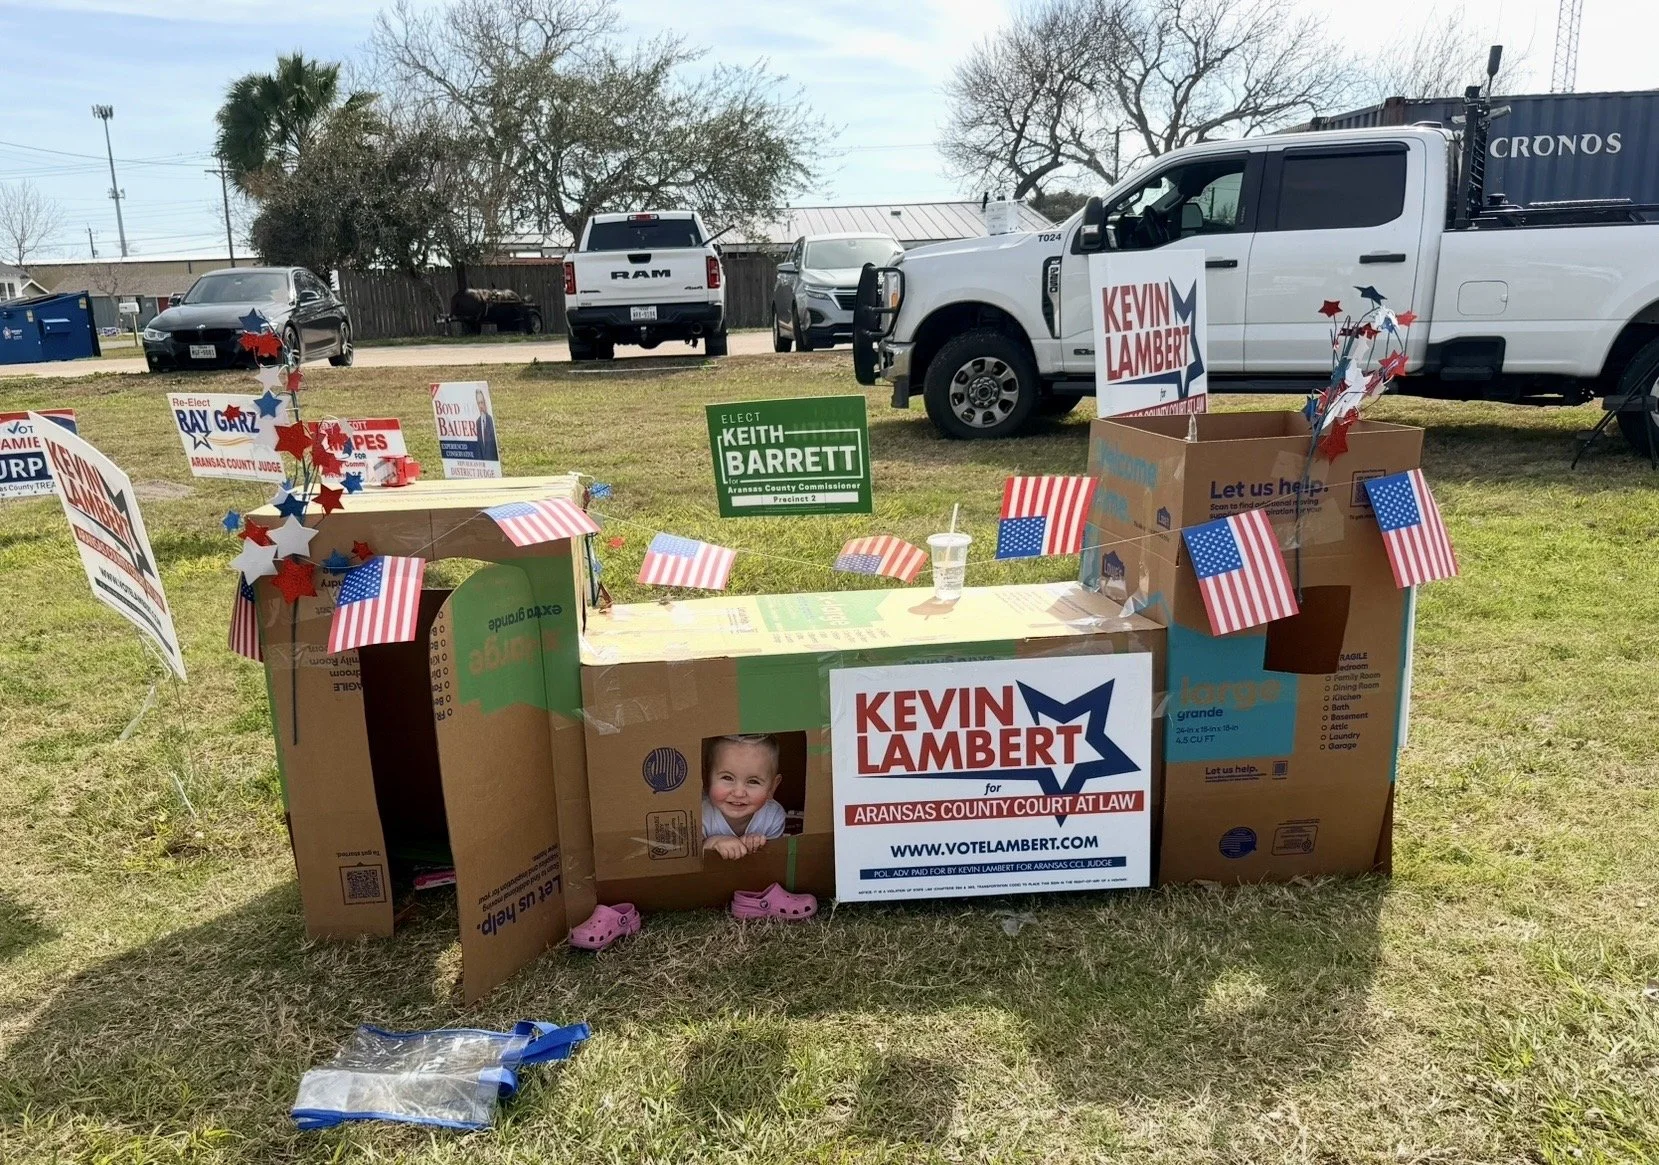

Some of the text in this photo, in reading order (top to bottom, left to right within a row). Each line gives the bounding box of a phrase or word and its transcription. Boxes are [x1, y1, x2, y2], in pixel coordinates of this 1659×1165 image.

[1489, 132, 1622, 158] CRONOS
[1038, 233, 1061, 242] T024
[611, 269, 671, 280] RAM
[1102, 282, 1170, 334] KEVIN
[1105, 325, 1189, 381] LAMBERT
[172, 398, 211, 407] Re-Elect
[435, 400, 460, 415] BOYD
[175, 410, 260, 433] RAY GARZ
[721, 412, 761, 424] ELECT
[8, 421, 34, 434] VOT
[438, 417, 478, 437] BAUER
[722, 424, 784, 446] KEITH
[1, 437, 41, 450] AMIE
[191, 457, 282, 473] ARANSAS COUNTY JUDGE
[725, 445, 856, 476] BARRETT
[44, 437, 107, 501] KEVIN
[9, 483, 34, 491] County
[728, 482, 860, 494] Aransas County Commissioner
[1210, 480, 1245, 499] Let
[1250, 482, 1273, 497] us
[773, 494, 816, 503] Precinct 2
[58, 472, 135, 550] LAMBERT
[1210, 503, 1229, 511] Scan
[1239, 500, 1253, 509] find
[1266, 508, 1293, 516] piration
[321, 579, 342, 589] ndry
[488, 604, 562, 633] extra grande
[340, 656, 359, 666] mily
[1339, 652, 1367, 660] RAGILE
[1338, 663, 1368, 671] edroom
[329, 670, 361, 679] droom
[1334, 672, 1380, 681] Family Room
[333, 681, 362, 692] AGILE
[1333, 682, 1379, 693] Dining Room
[1181, 676, 1280, 712] large
[1332, 693, 1361, 701] Kitchen
[856, 686, 1014, 733] KEVIN
[1331, 703, 1349, 711] Bath
[1177, 707, 1223, 721] grande
[1330, 712, 1368, 721] Basement
[1190, 735, 1203, 743] CU
[1329, 732, 1360, 741] Laundry
[857, 725, 1082, 775] LAMBERT
[1328, 742, 1357, 750] Garage
[1205, 766, 1221, 775] Let
[1235, 764, 1258, 773] help.
[984, 783, 1001, 796] for
[854, 793, 1136, 823] ARANSAS COUNTY COURT AT LAW
[891, 835, 1098, 858] WWW.VOTELAMBERT.COM
[911, 868, 929, 876] PAID
[930, 867, 946, 875] FOR
[947, 866, 958, 874] BY
[958, 865, 980, 873] KEVIN
[982, 863, 1014, 872] LAMBERT
[1016, 863, 1032, 871] FOR
[1033, 861, 1068, 870] ARANSAS
[1087, 859, 1112, 867] JUDGE
[476, 875, 561, 937] Let us help.
